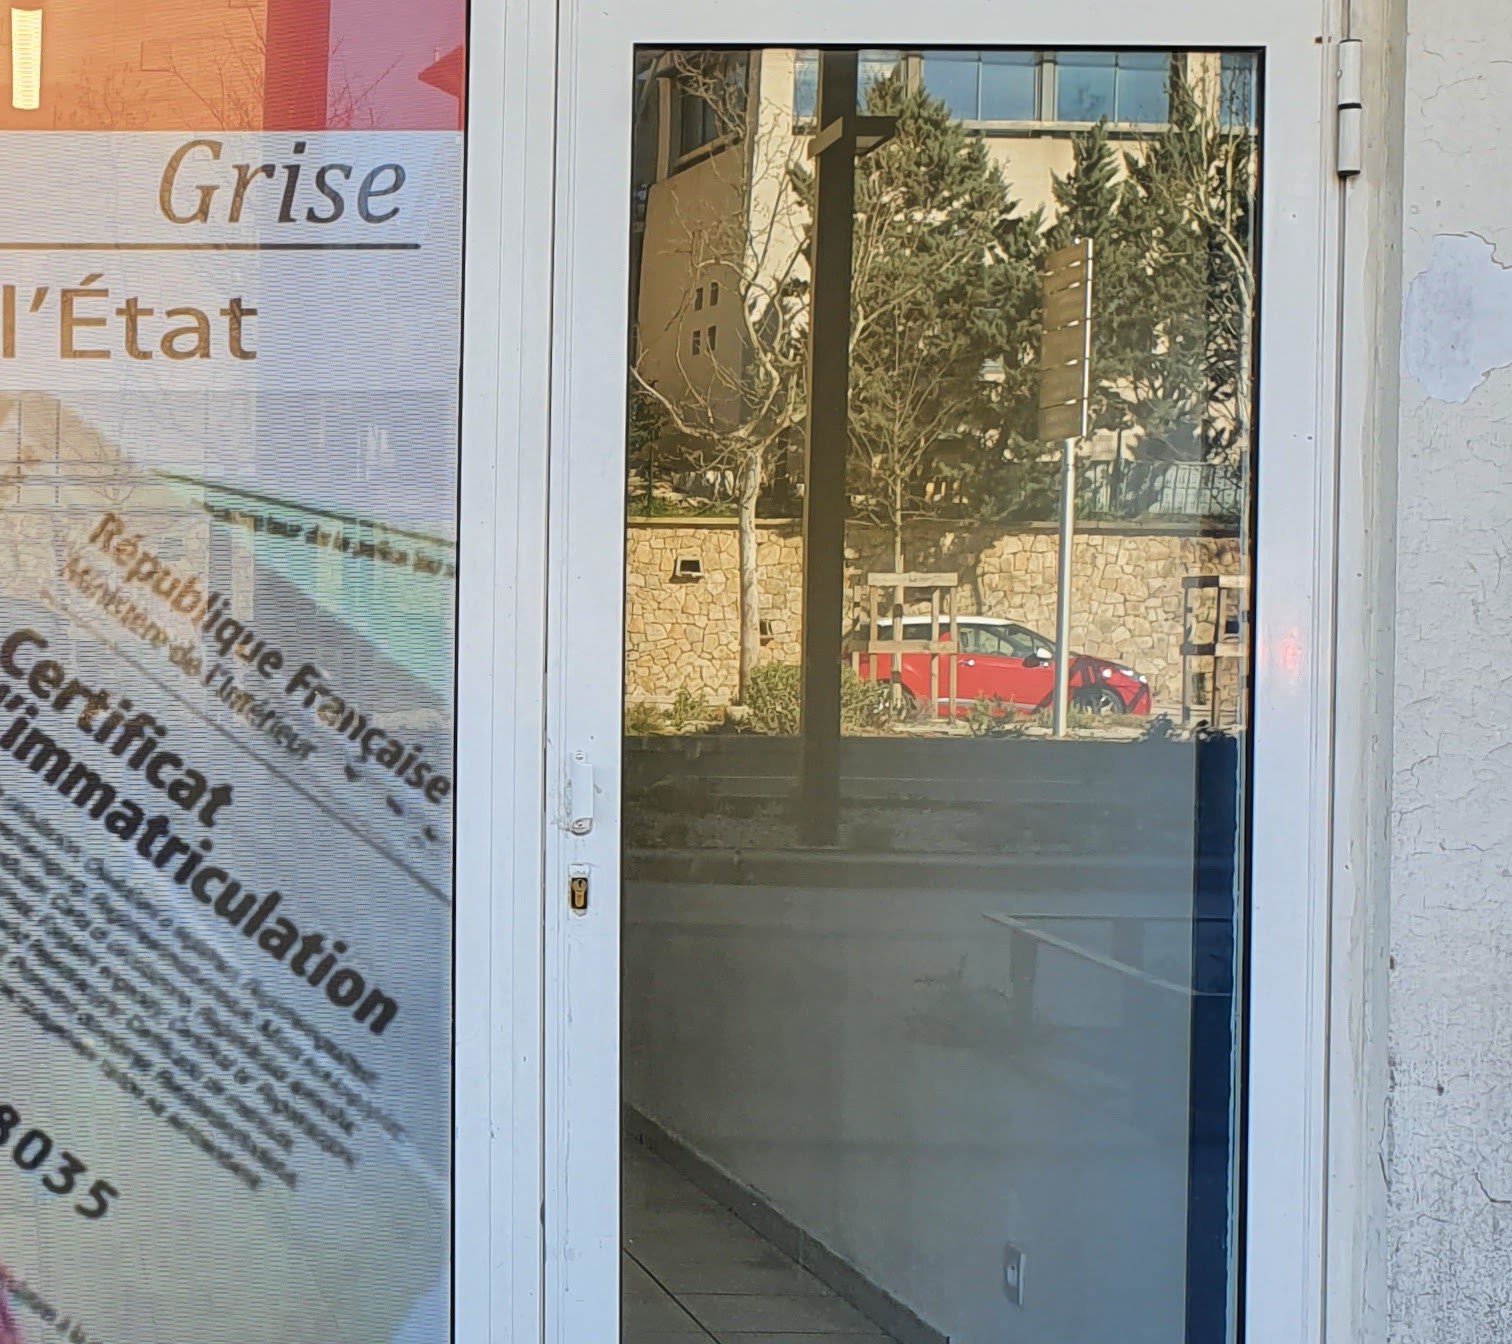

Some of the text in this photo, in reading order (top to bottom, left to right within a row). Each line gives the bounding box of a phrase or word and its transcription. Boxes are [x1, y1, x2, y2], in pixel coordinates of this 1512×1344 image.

[158, 140, 408, 228] Grise
[87, 512, 284, 678] République
[285, 662, 452, 806] Française
